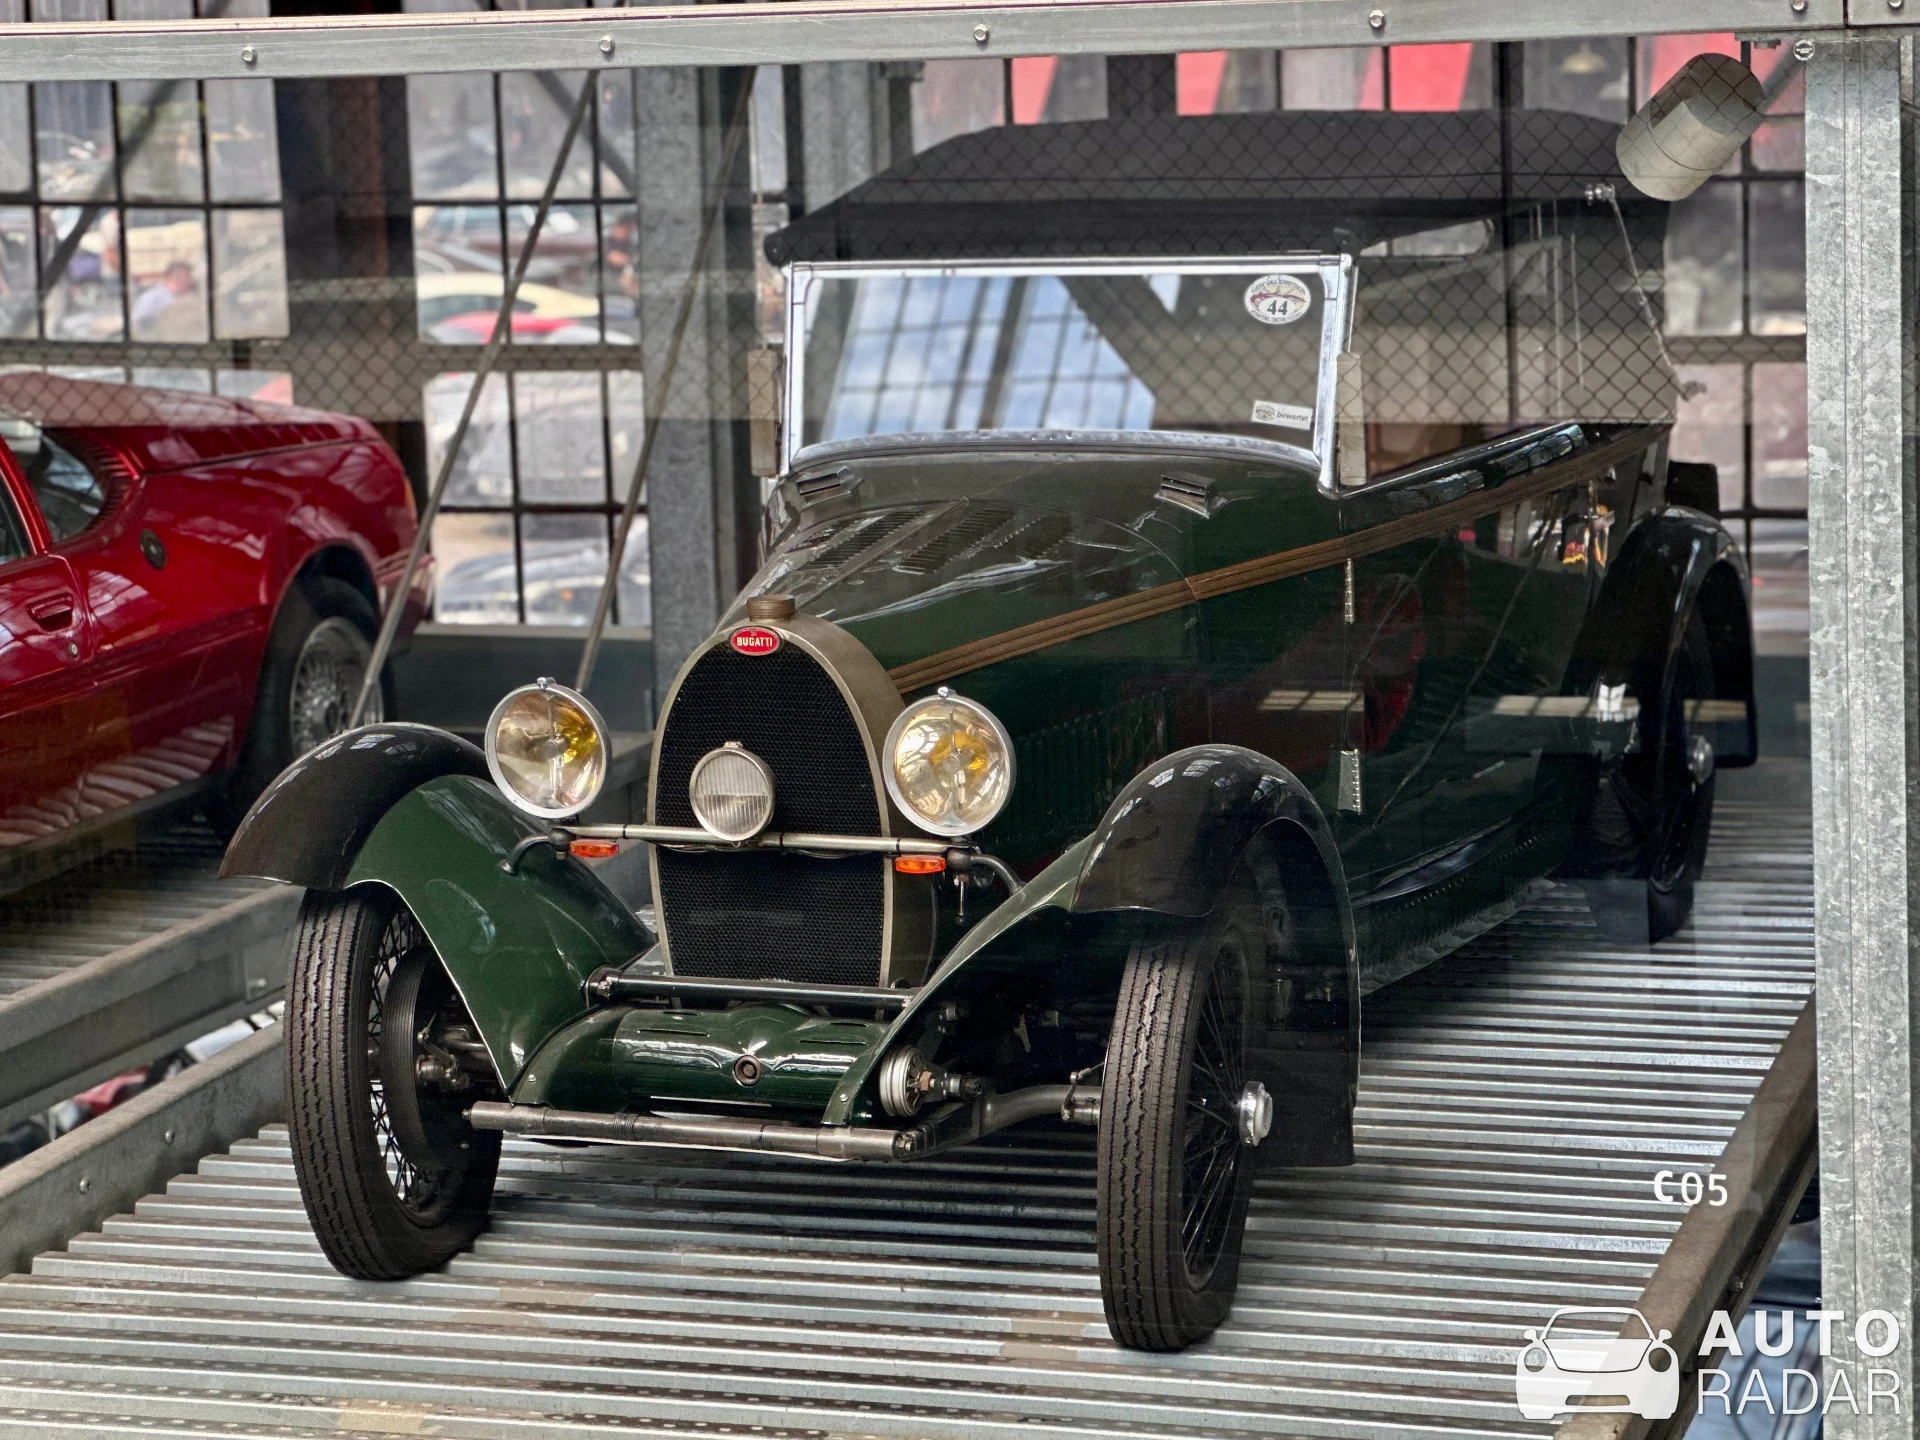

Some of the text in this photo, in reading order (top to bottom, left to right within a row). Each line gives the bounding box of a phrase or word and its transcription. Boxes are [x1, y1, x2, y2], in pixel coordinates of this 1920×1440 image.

[1267, 300, 1288, 315] 44
[736, 636, 773, 647] BUGATTI
[1654, 1170, 1728, 1206] C05
